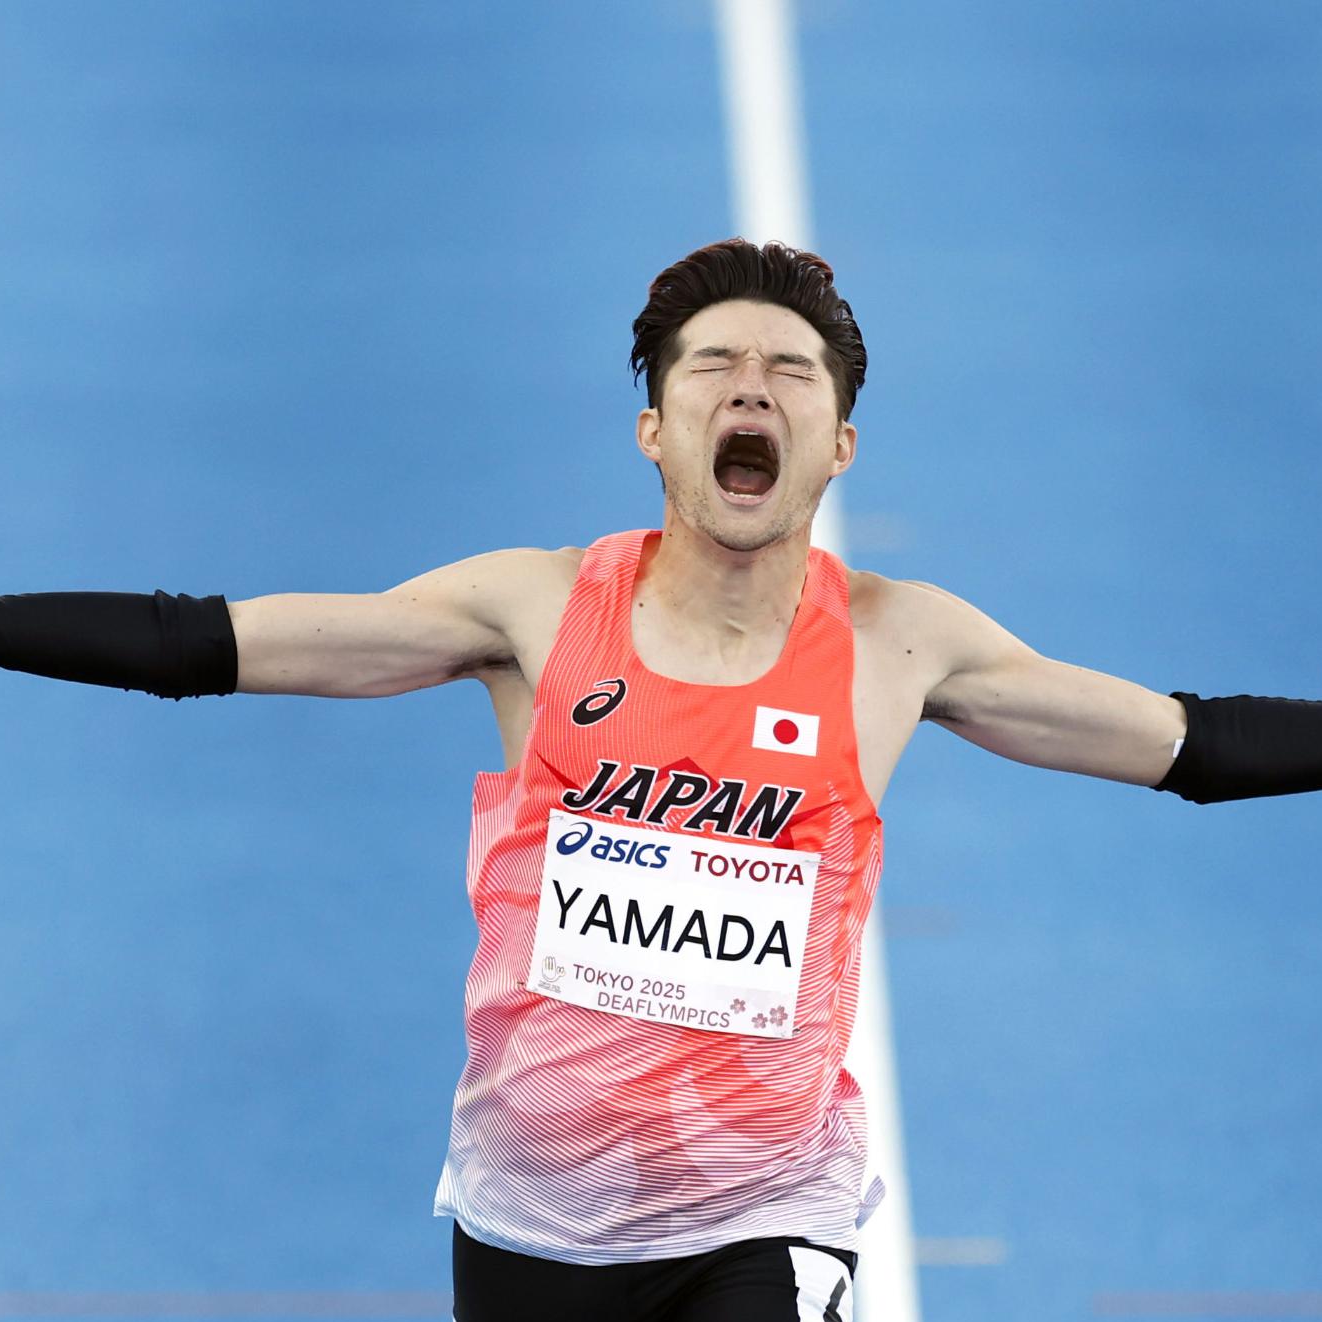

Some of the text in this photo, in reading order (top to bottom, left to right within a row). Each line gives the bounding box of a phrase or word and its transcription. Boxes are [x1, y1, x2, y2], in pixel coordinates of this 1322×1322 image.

[561, 759, 805, 843] JAPAN
[690, 850, 805, 886] TOYOTA
[551, 879, 792, 968] YAMADA
[573, 963, 634, 992] TOKYO
[640, 978, 686, 1001] 2025
[597, 991, 731, 1028] DEAFLYMPICS
